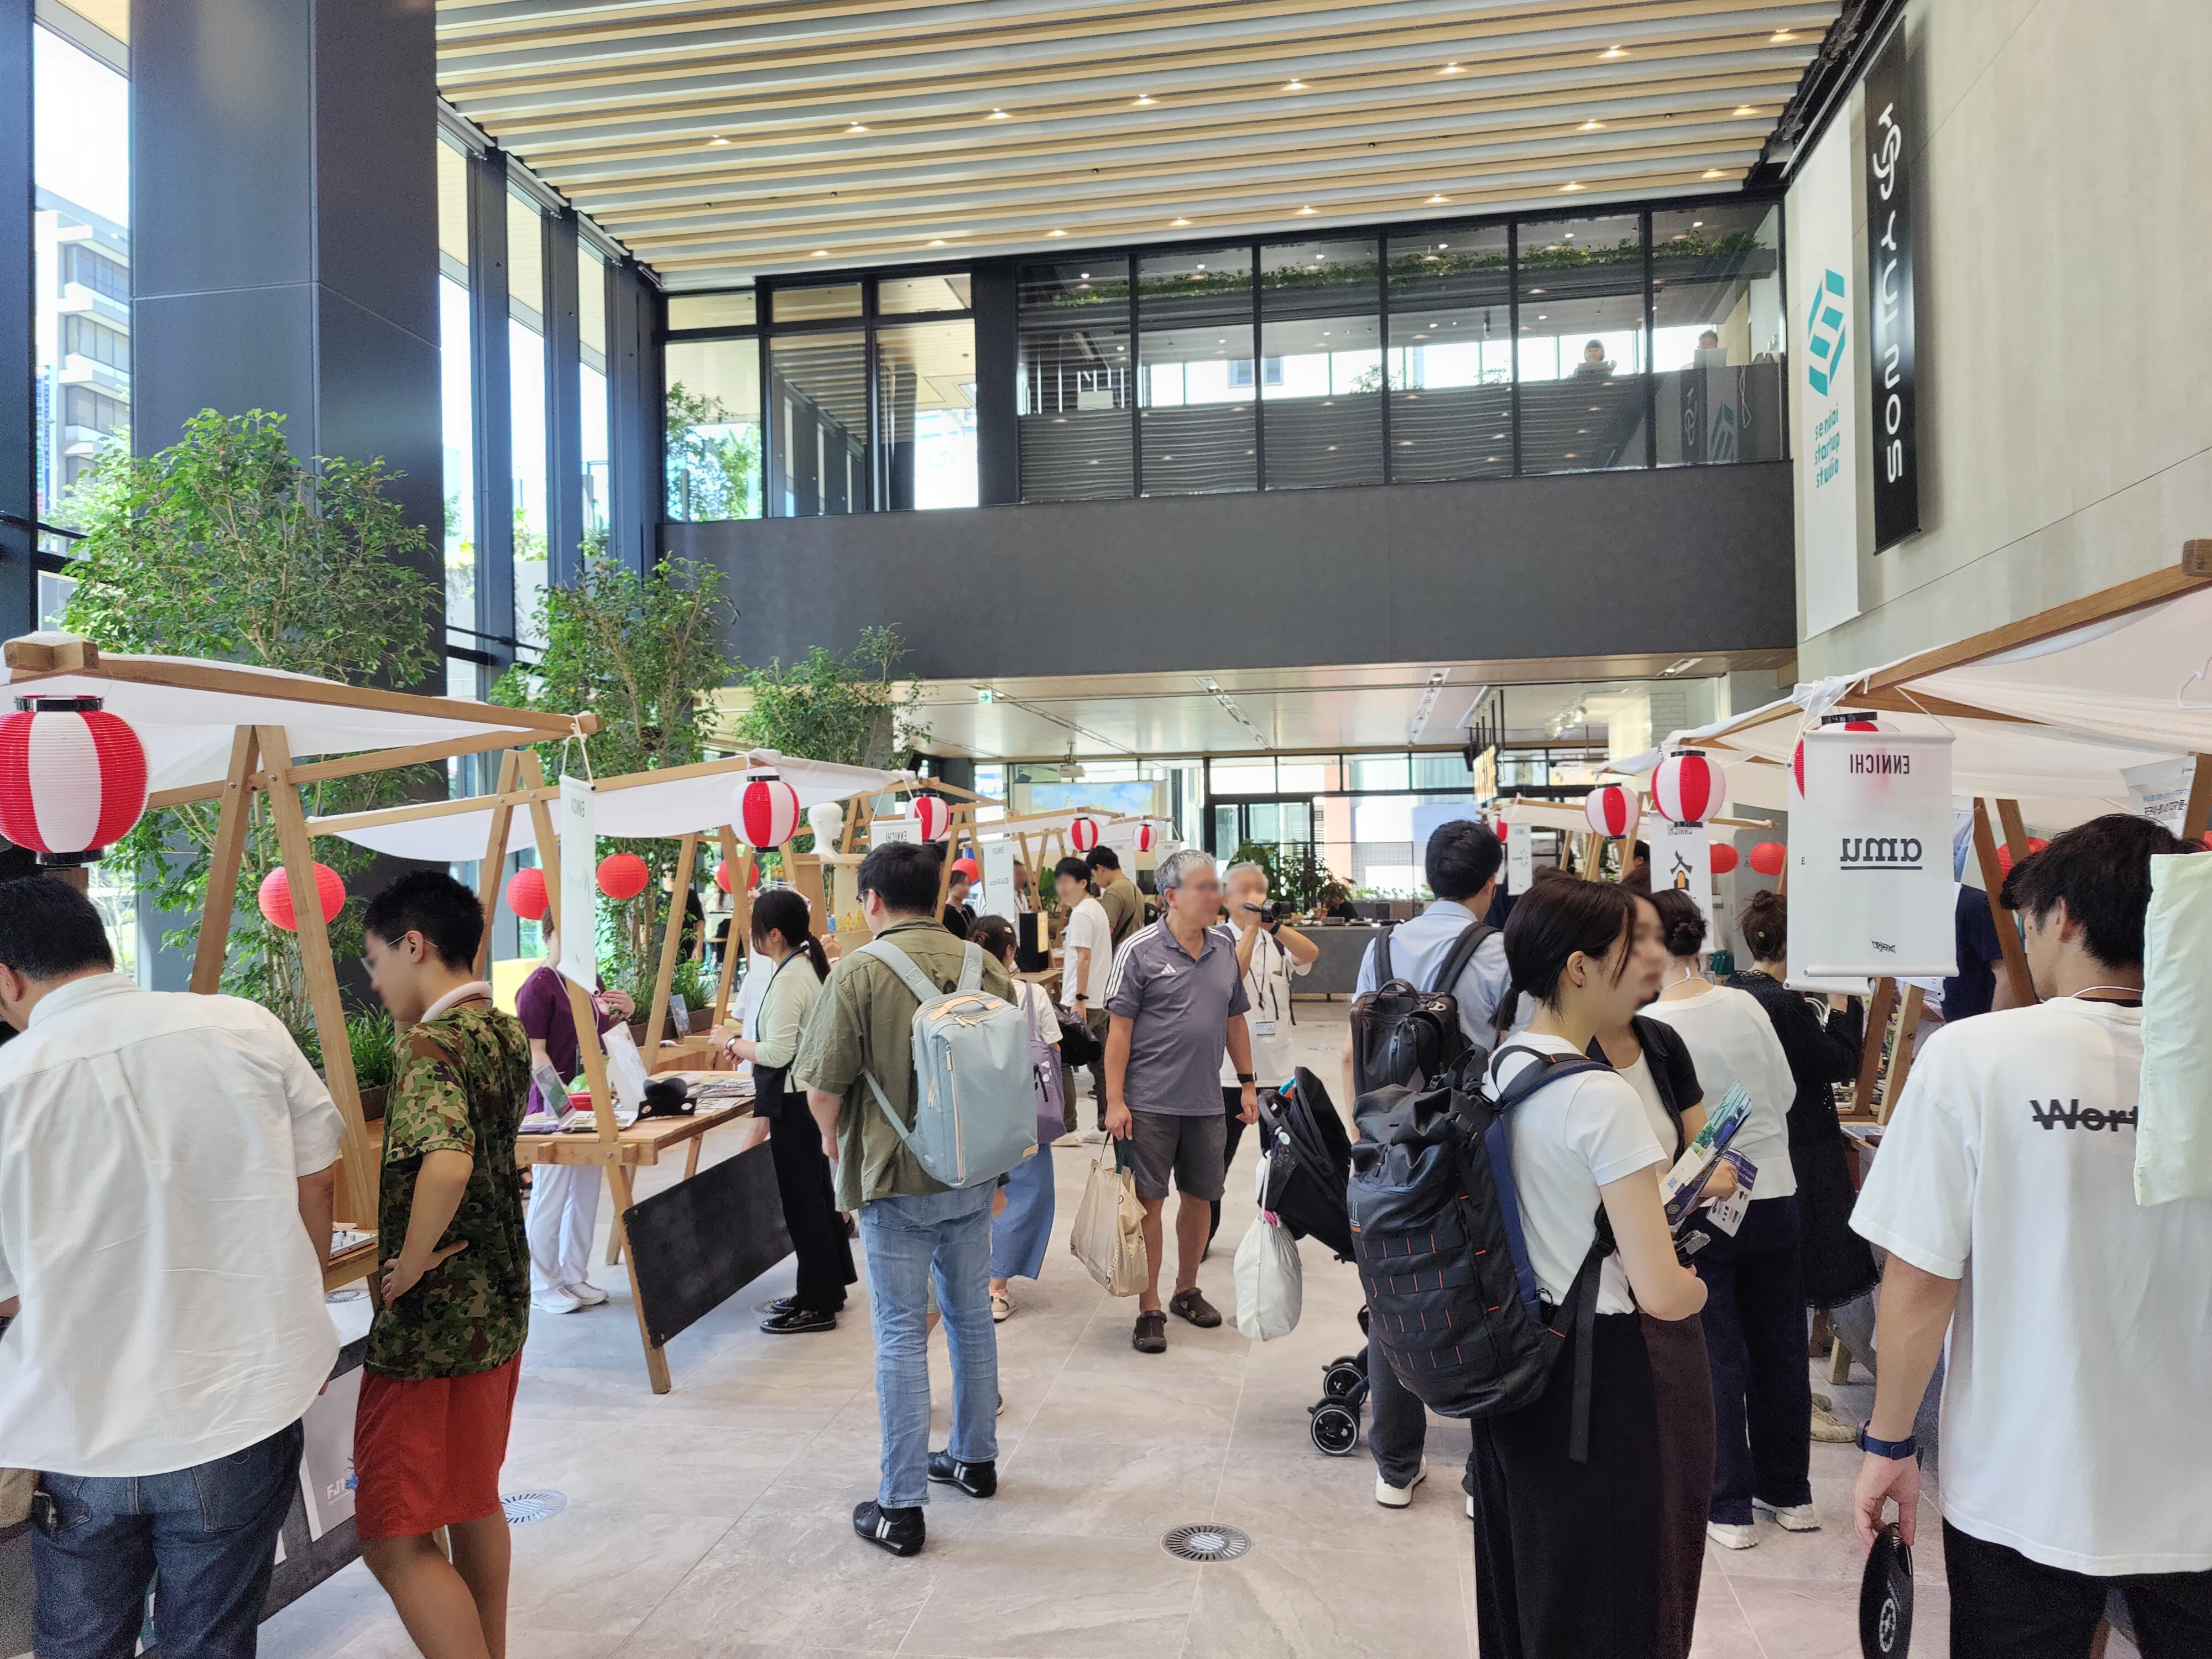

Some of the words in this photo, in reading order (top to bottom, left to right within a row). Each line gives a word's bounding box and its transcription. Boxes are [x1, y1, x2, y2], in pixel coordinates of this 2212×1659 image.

[1881, 210, 1903, 484] YUINOS
[1814, 402, 1839, 441] sendai
[1814, 431, 1841, 466] startup
[1816, 456, 1840, 489] studio
